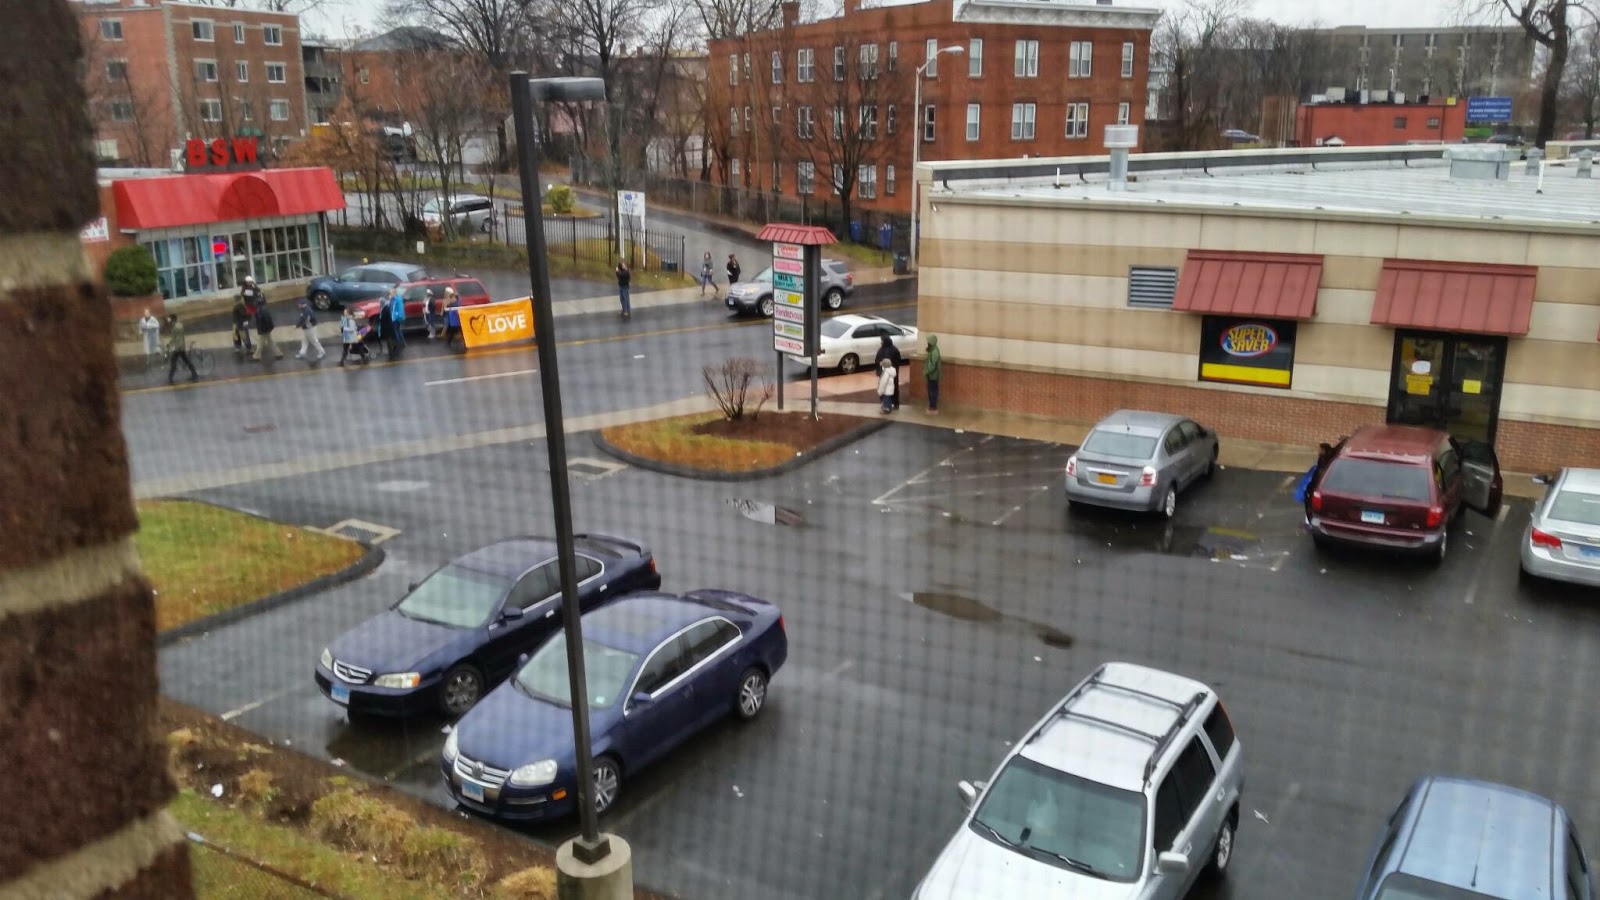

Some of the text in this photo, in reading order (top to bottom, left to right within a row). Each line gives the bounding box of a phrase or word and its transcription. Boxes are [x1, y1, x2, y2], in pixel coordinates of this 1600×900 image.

[187, 136, 257, 167] BSW
[487, 313, 527, 334] LOVE
[1229, 327, 1266, 341] SUPER
[1230, 339, 1270, 352] SAVER
